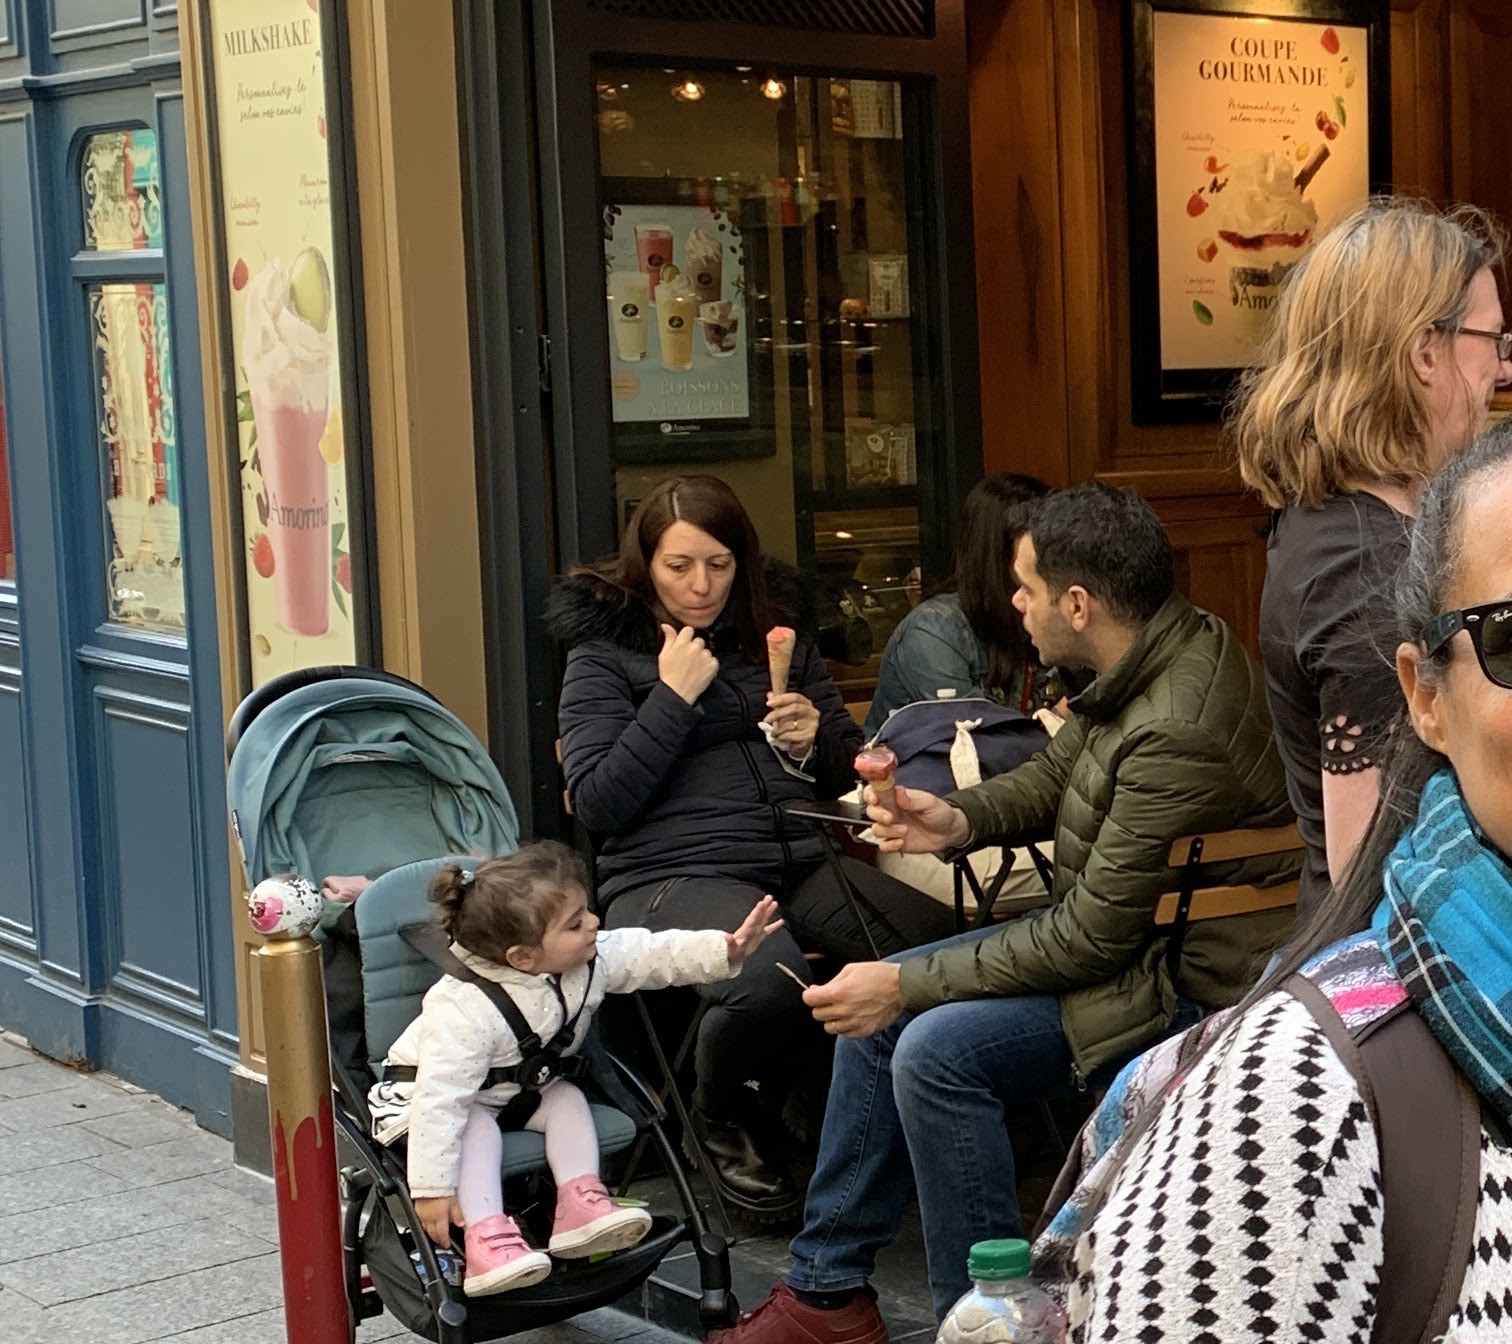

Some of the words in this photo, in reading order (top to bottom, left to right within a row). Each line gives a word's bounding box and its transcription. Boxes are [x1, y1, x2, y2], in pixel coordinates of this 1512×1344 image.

[224, 19, 312, 57] MILKSHAKE
[1230, 37, 1298, 61] COUPE
[1198, 60, 1329, 87] GOURMANDE
[661, 379, 740, 395] BOISSONS
[663, 400, 683, 416] LA
[686, 398, 740, 415] GLACE
[269, 490, 330, 530] Amorino
